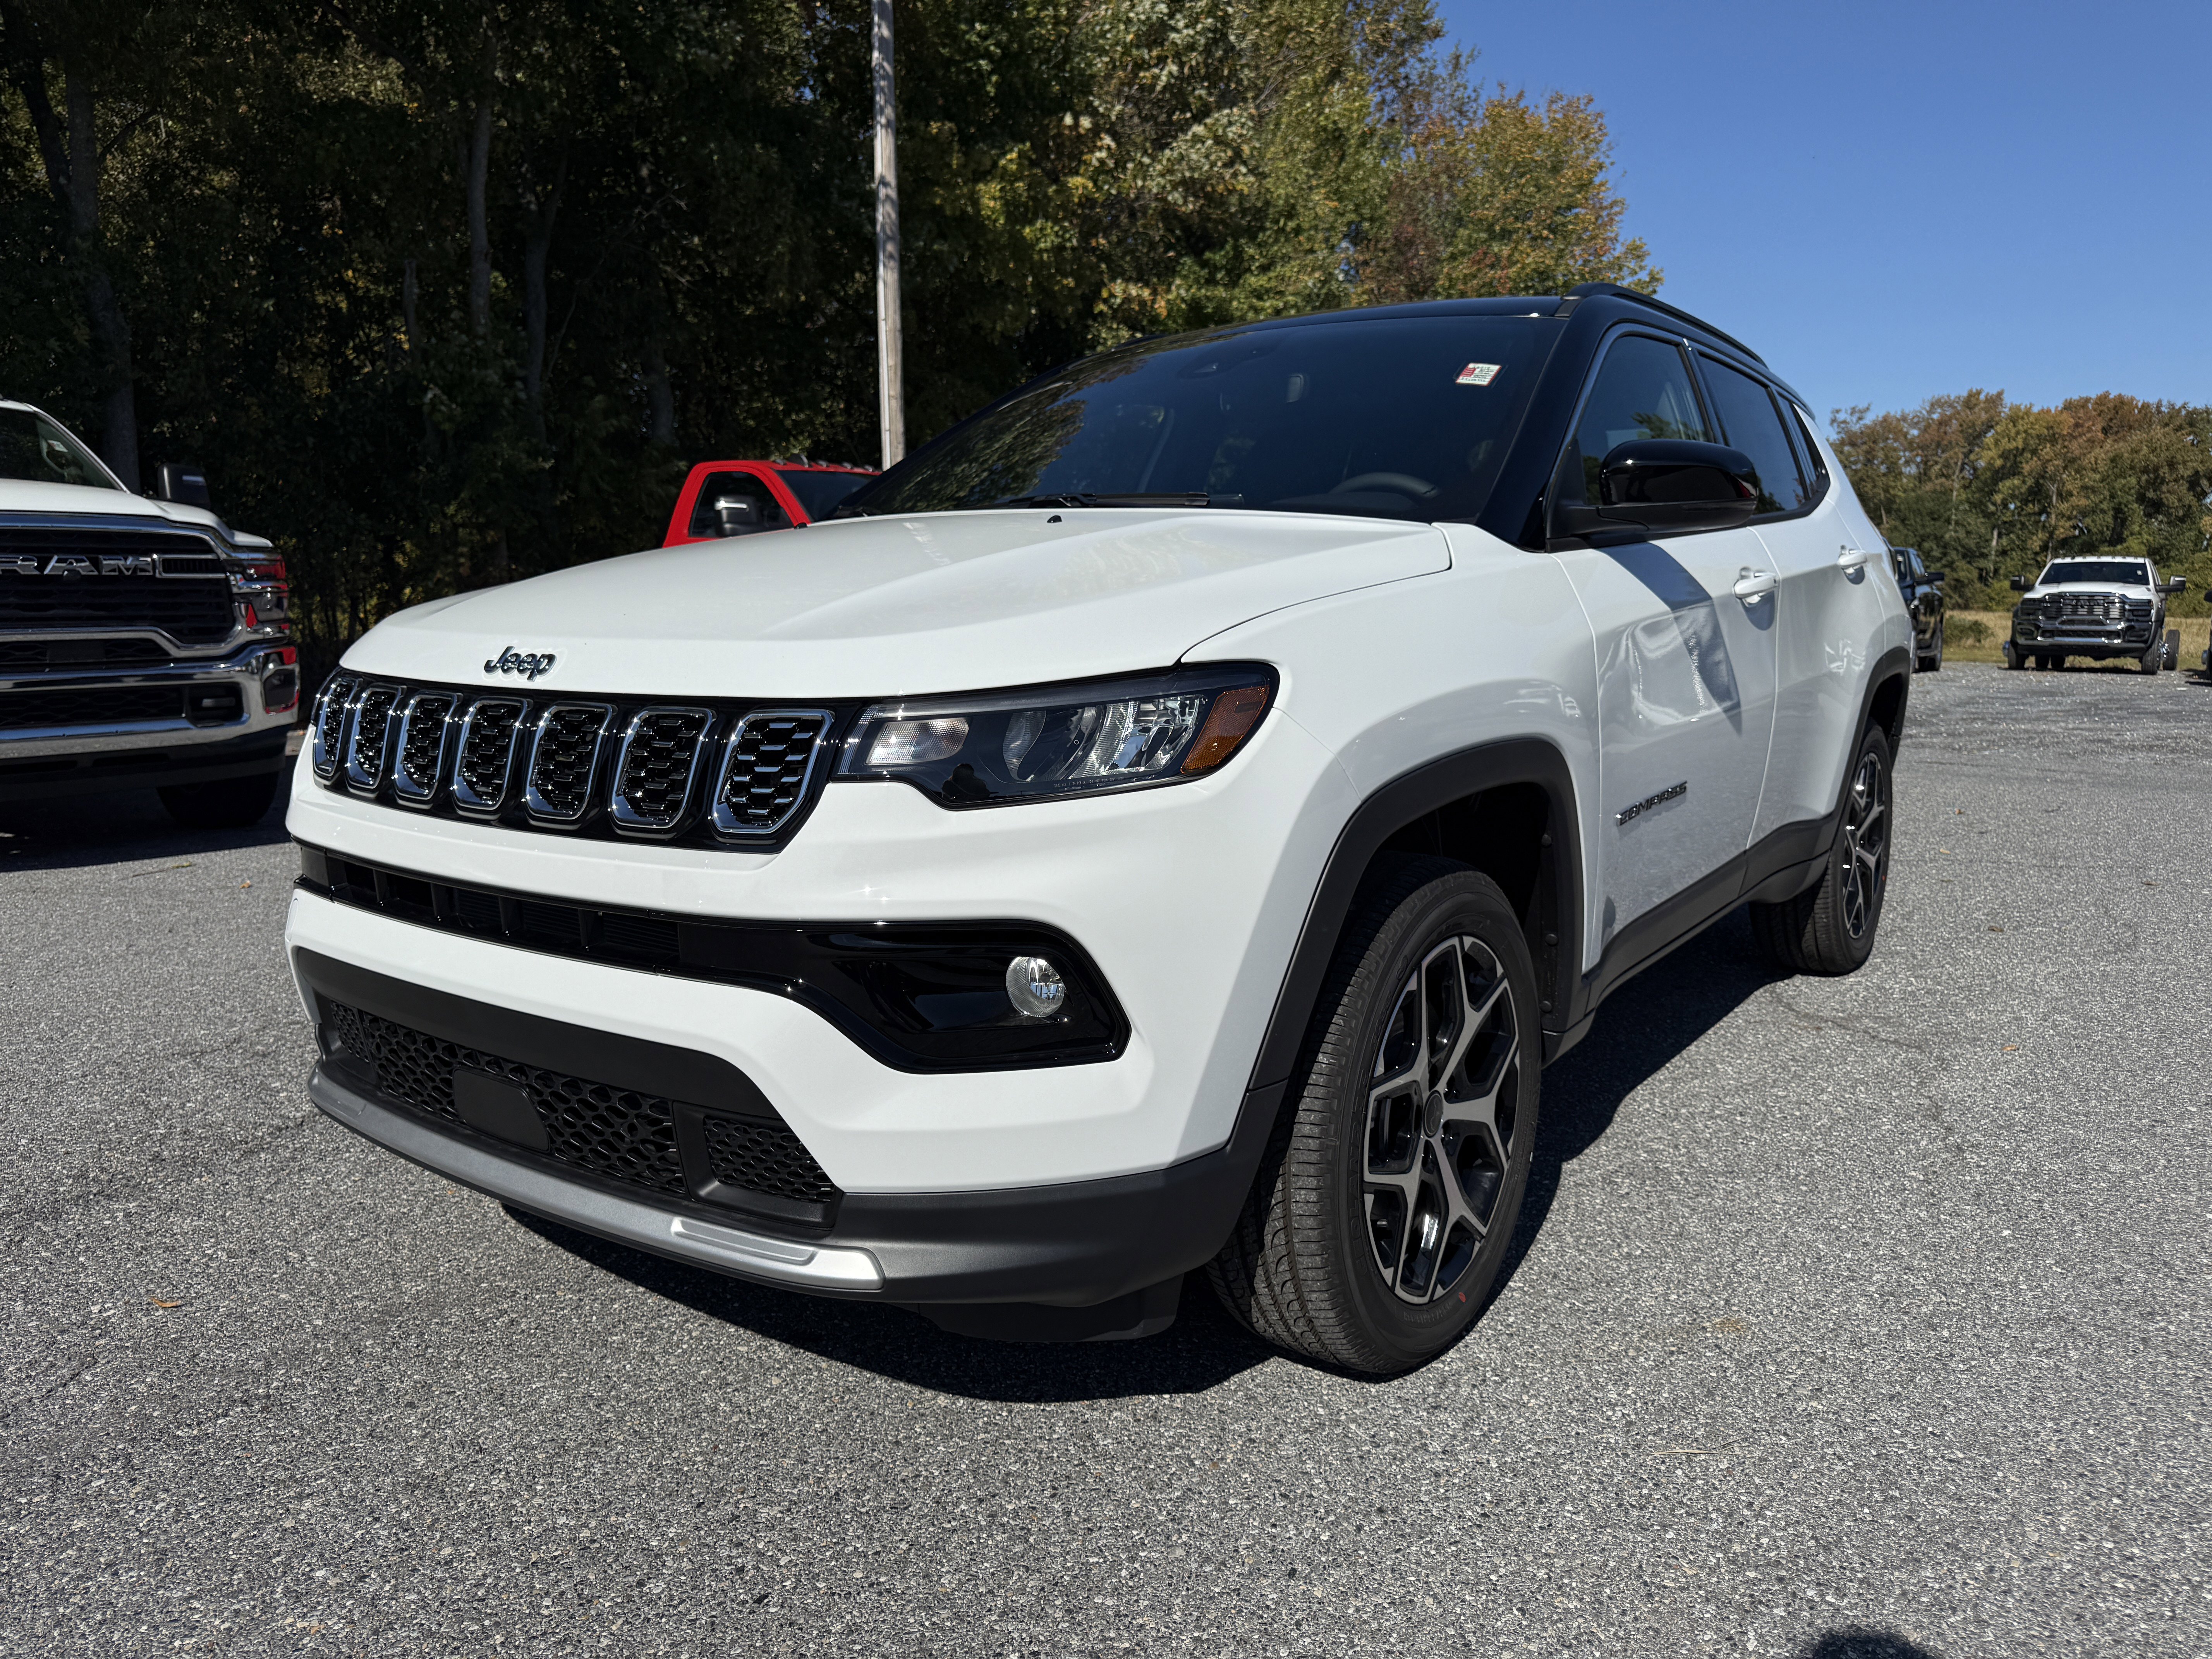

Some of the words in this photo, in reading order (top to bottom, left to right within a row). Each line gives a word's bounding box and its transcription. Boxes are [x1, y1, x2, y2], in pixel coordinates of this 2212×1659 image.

[0, 555, 153, 576] RAM
[484, 646, 557, 682] Jeep
[1616, 780, 1687, 826] COMPASS
